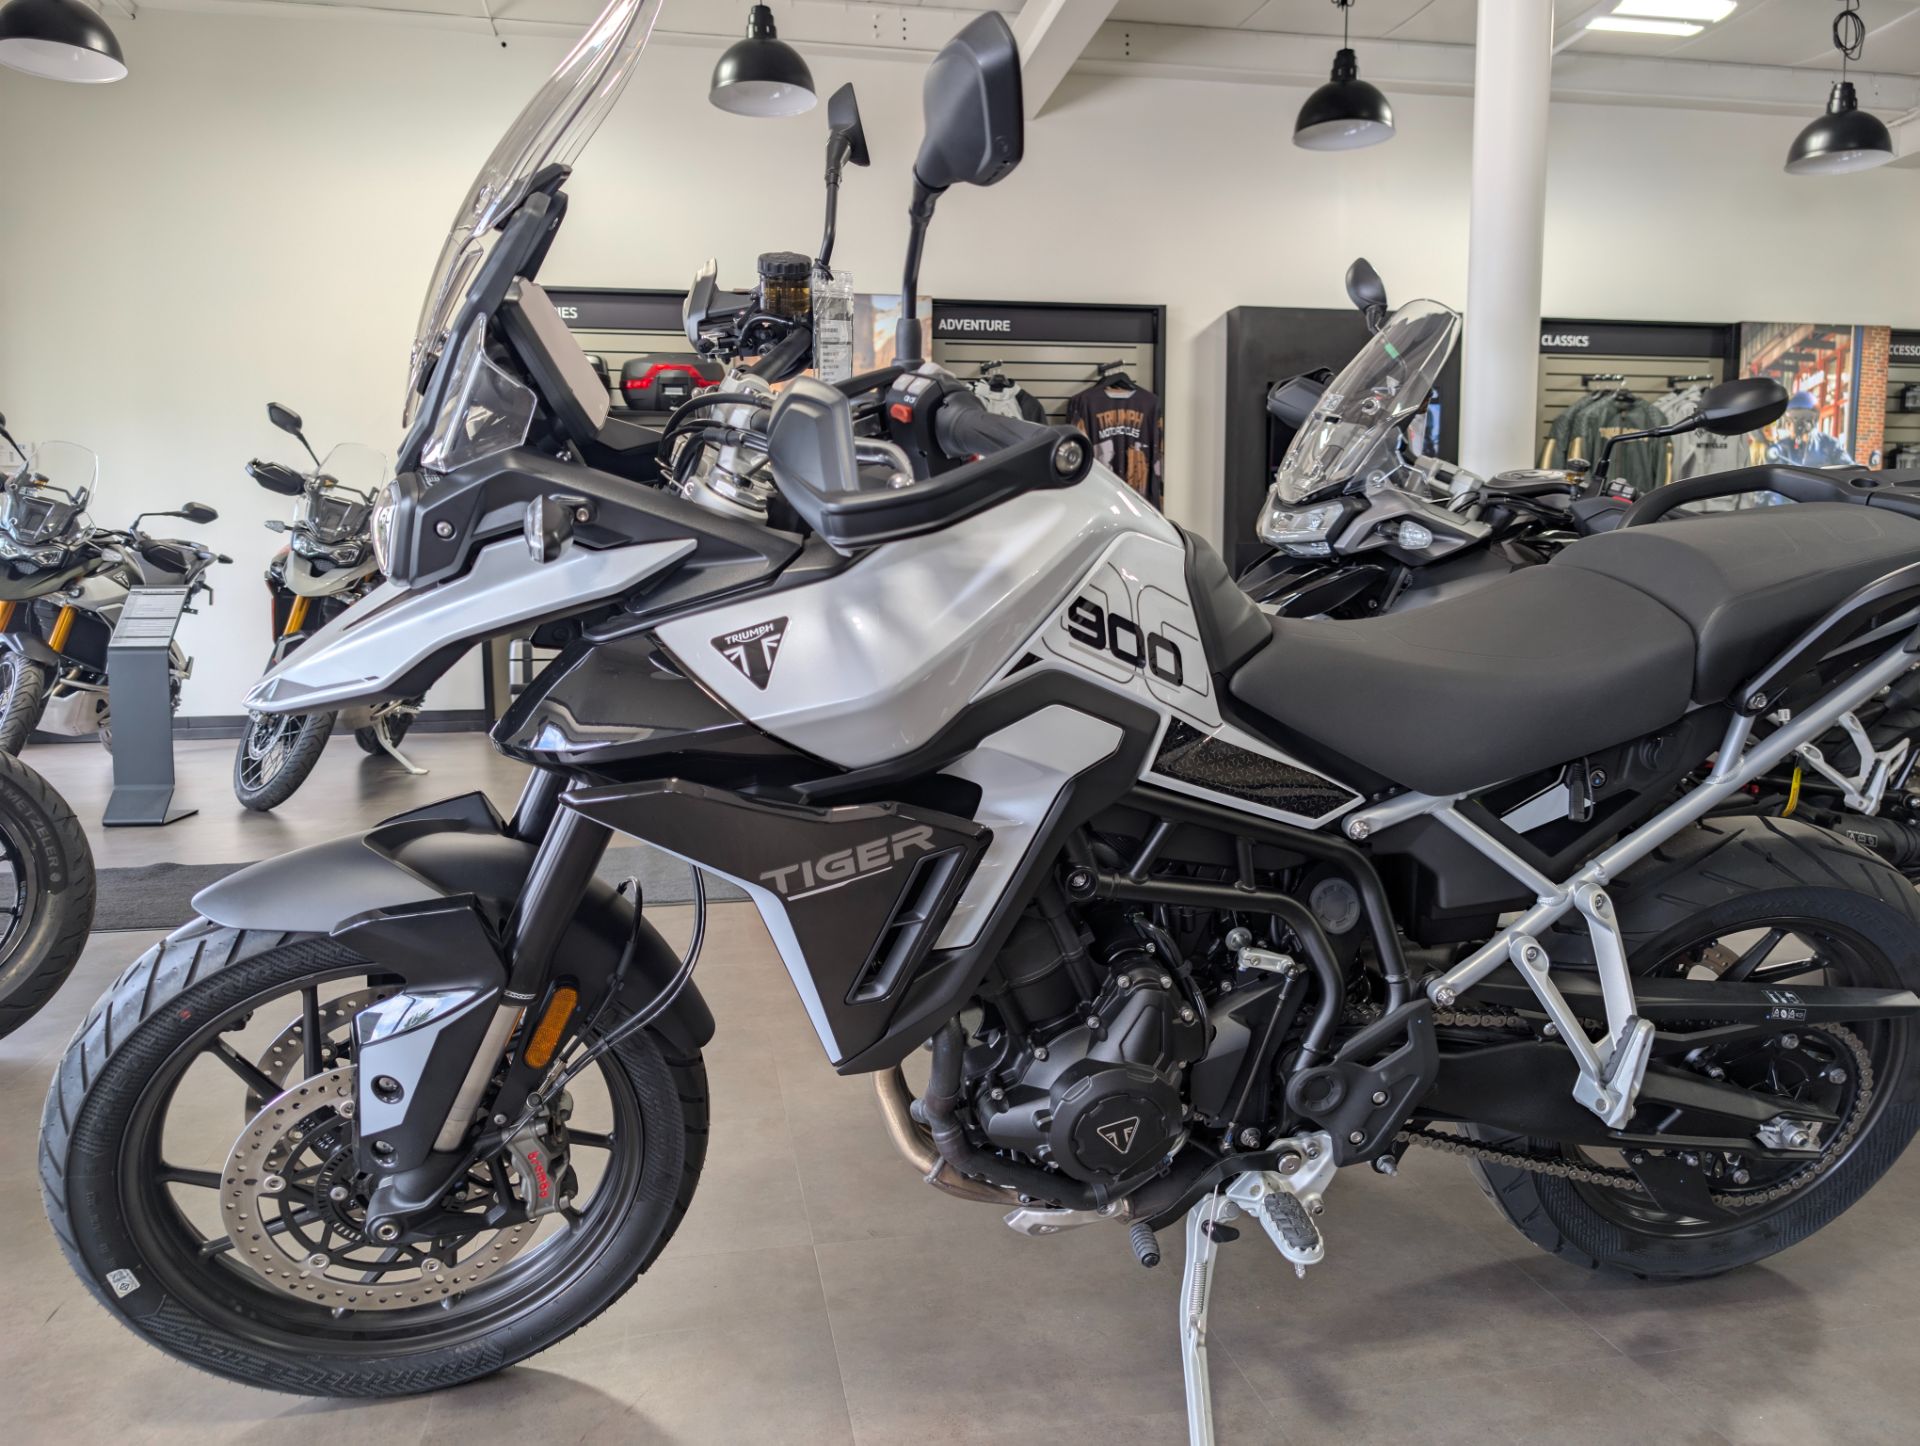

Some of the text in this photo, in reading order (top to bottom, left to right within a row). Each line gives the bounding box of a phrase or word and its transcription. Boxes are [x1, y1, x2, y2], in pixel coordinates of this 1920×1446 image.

[938, 318, 1011, 332] ADVENTURE
[1541, 334, 1590, 347] CLASSICS
[724, 622, 775, 645] TRIUMPH
[1067, 595, 1184, 687] 900
[4, 787, 60, 868] METZELER
[759, 825, 936, 894] TIGER
